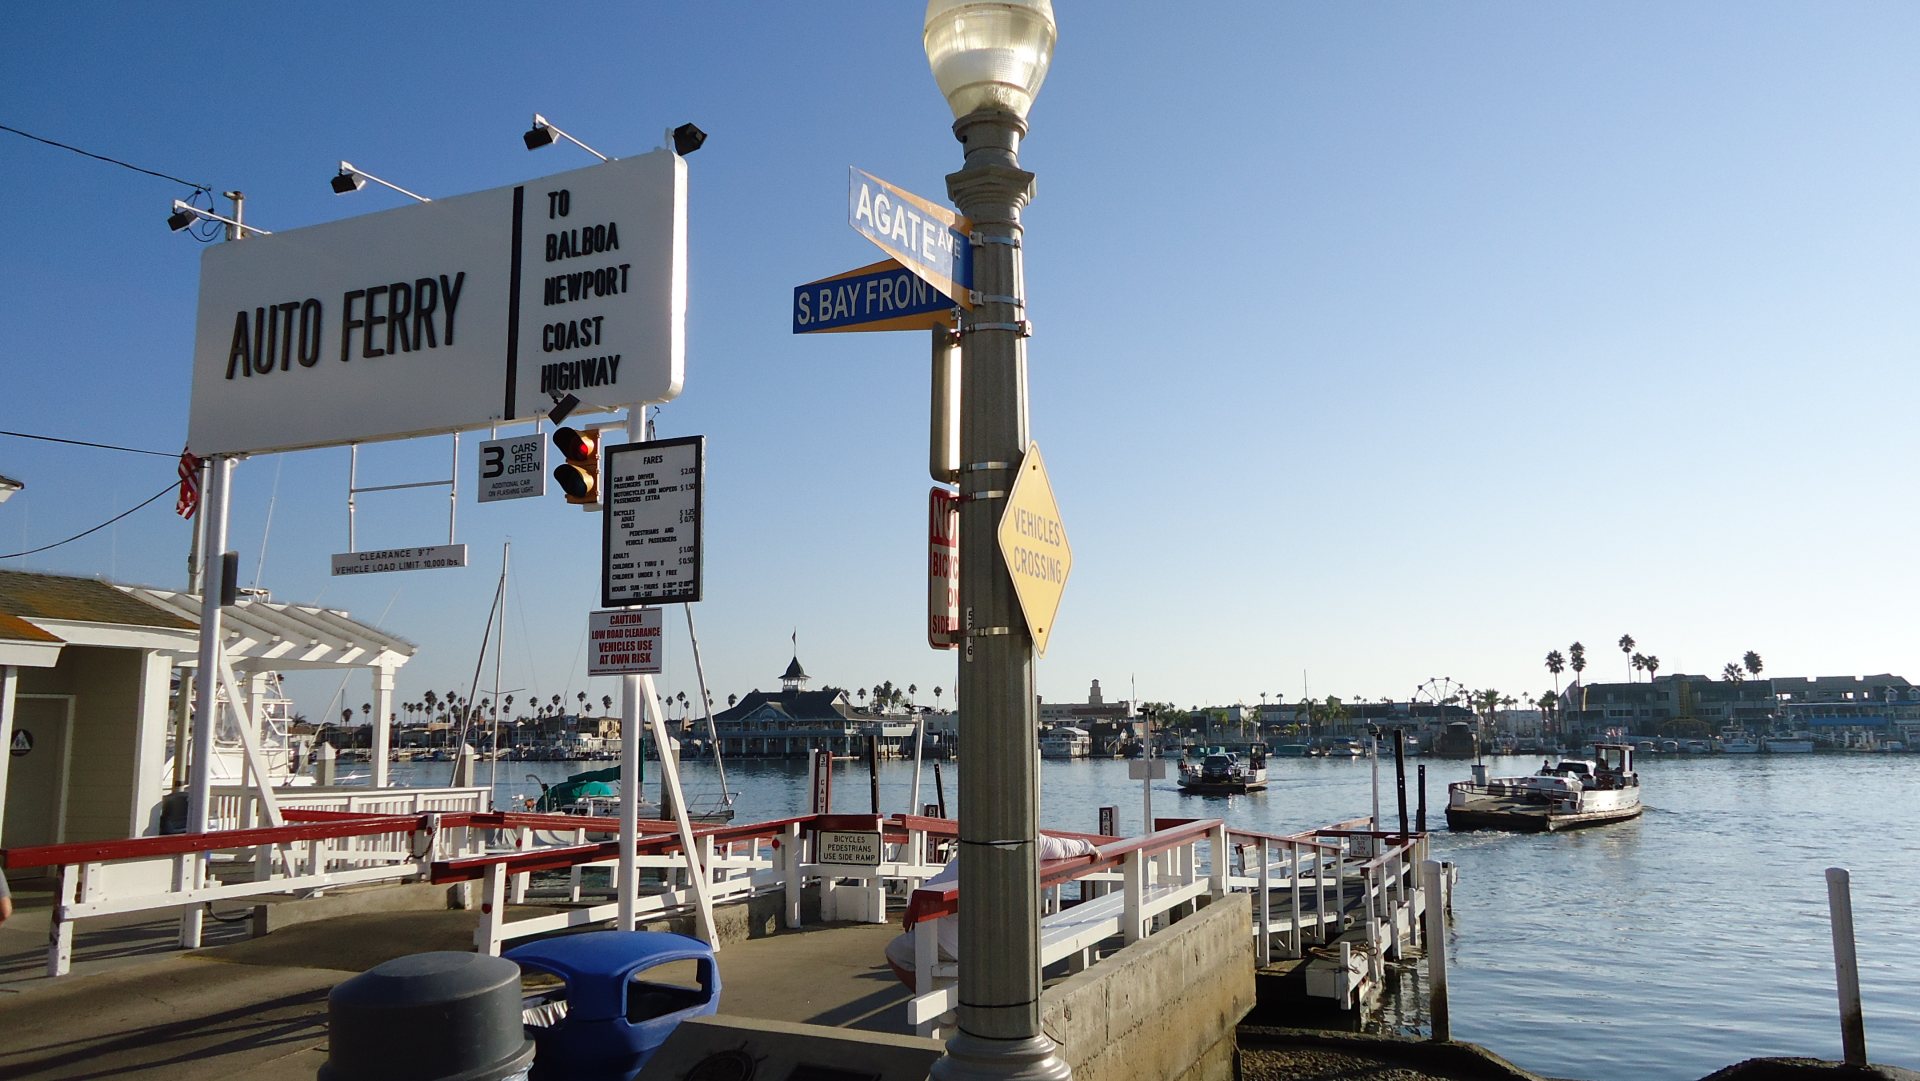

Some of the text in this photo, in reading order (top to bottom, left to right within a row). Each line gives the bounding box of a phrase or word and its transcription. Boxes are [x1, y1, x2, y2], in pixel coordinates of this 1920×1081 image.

[547, 188, 570, 219] TO
[855, 183, 936, 262] AGATE
[545, 222, 620, 262] BALBOA
[543, 264, 632, 306] NEWPORT
[819, 283, 861, 322] BAY
[225, 271, 466, 380] AUTO FERRY
[542, 316, 604, 353] COAST
[540, 354, 621, 394] HIGHWAY
[511, 442, 538, 454] CARS
[483, 446, 505, 478] 3
[514, 453, 533, 463] PER
[643, 455, 664, 465] FARES
[507, 462, 541, 475] GREEN
[613, 489, 646, 498] MOTORCYCLES
[933, 496, 955, 541] NO
[1013, 506, 1061, 547] VEHICLES
[359, 549, 411, 561] CLEARANCE
[335, 565, 369, 575] VEHICLE
[373, 563, 396, 572] LOAD
[398, 560, 420, 570] LIMIT
[1013, 546, 1062, 584] CROSSING
[610, 614, 642, 625] CAUTION
[591, 627, 661, 640] LOW ROAD CLEARANCE
[598, 640, 653, 653] VEHICLES USE
[599, 652, 651, 665] AT OWN RISK
[833, 835, 866, 844] BICYCLES
[827, 844, 872, 853] PEDESTRIANS
[823, 852, 876, 862] USE SIDE RAMP
